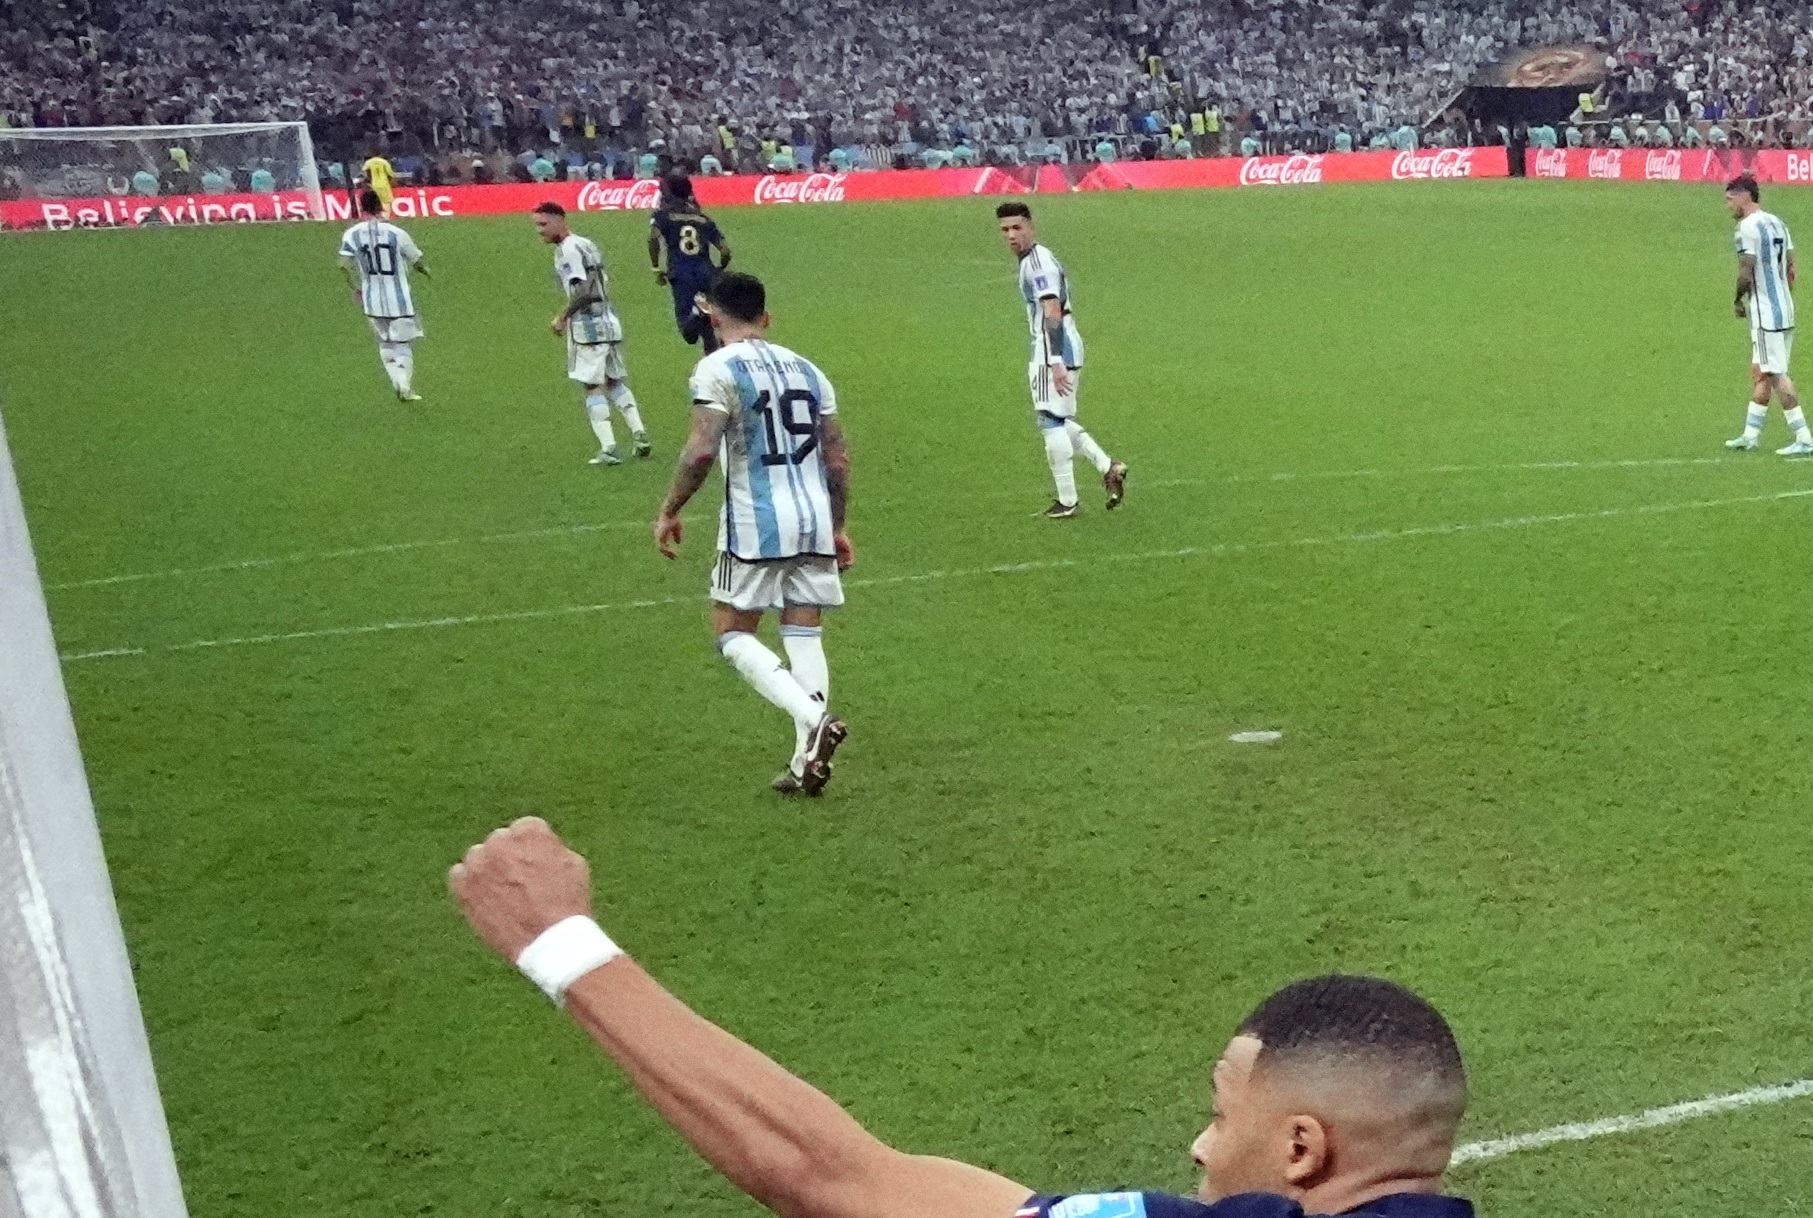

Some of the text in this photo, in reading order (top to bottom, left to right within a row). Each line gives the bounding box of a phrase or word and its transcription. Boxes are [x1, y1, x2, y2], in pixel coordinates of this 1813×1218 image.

[325, 189, 454, 221] Mgic
[578, 180, 661, 211] Coca-Col
[679, 225, 700, 255] 8
[360, 244, 397, 275] 10
[752, 389, 819, 466] 19
